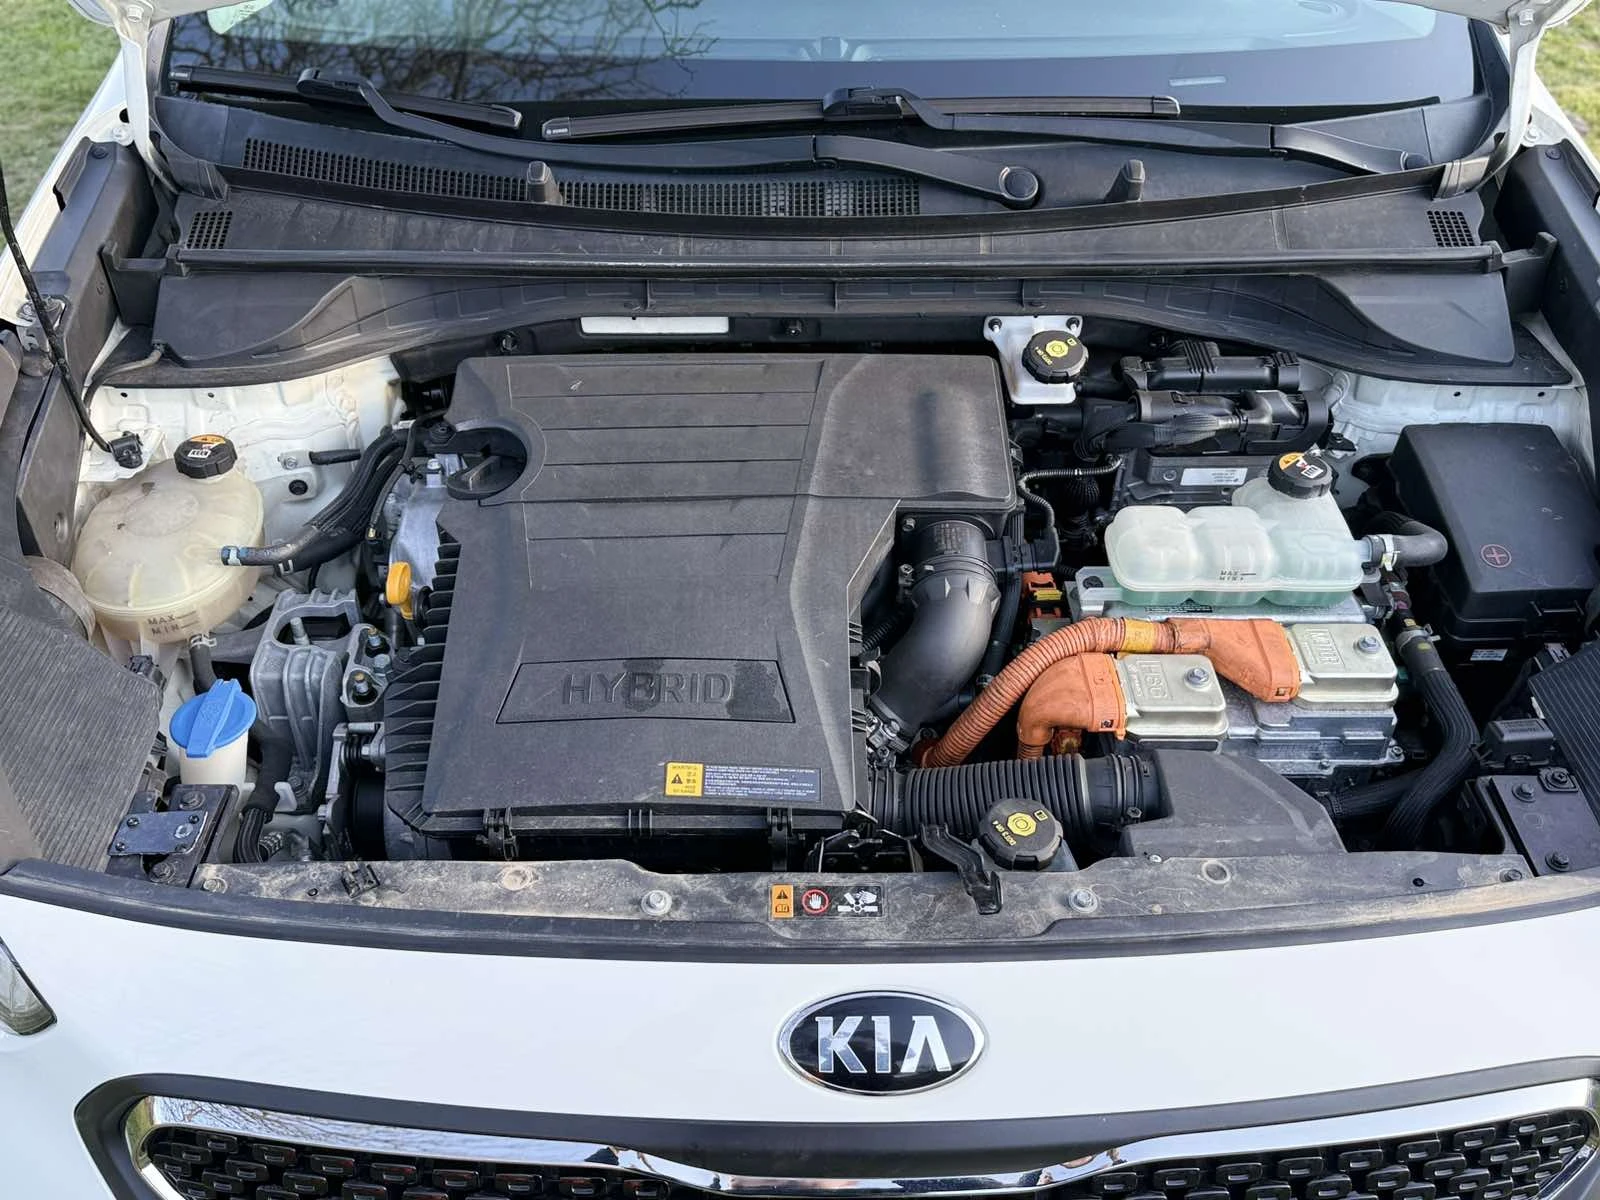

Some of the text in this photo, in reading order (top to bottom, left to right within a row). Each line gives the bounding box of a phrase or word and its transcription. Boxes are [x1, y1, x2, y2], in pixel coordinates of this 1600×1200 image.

[147, 614, 176, 625] MAX
[151, 624, 180, 636] MIN
[562, 671, 734, 704] HYBRID
[1001, 831, 1017, 846] DOT3
[815, 1016, 952, 1073] KIA
